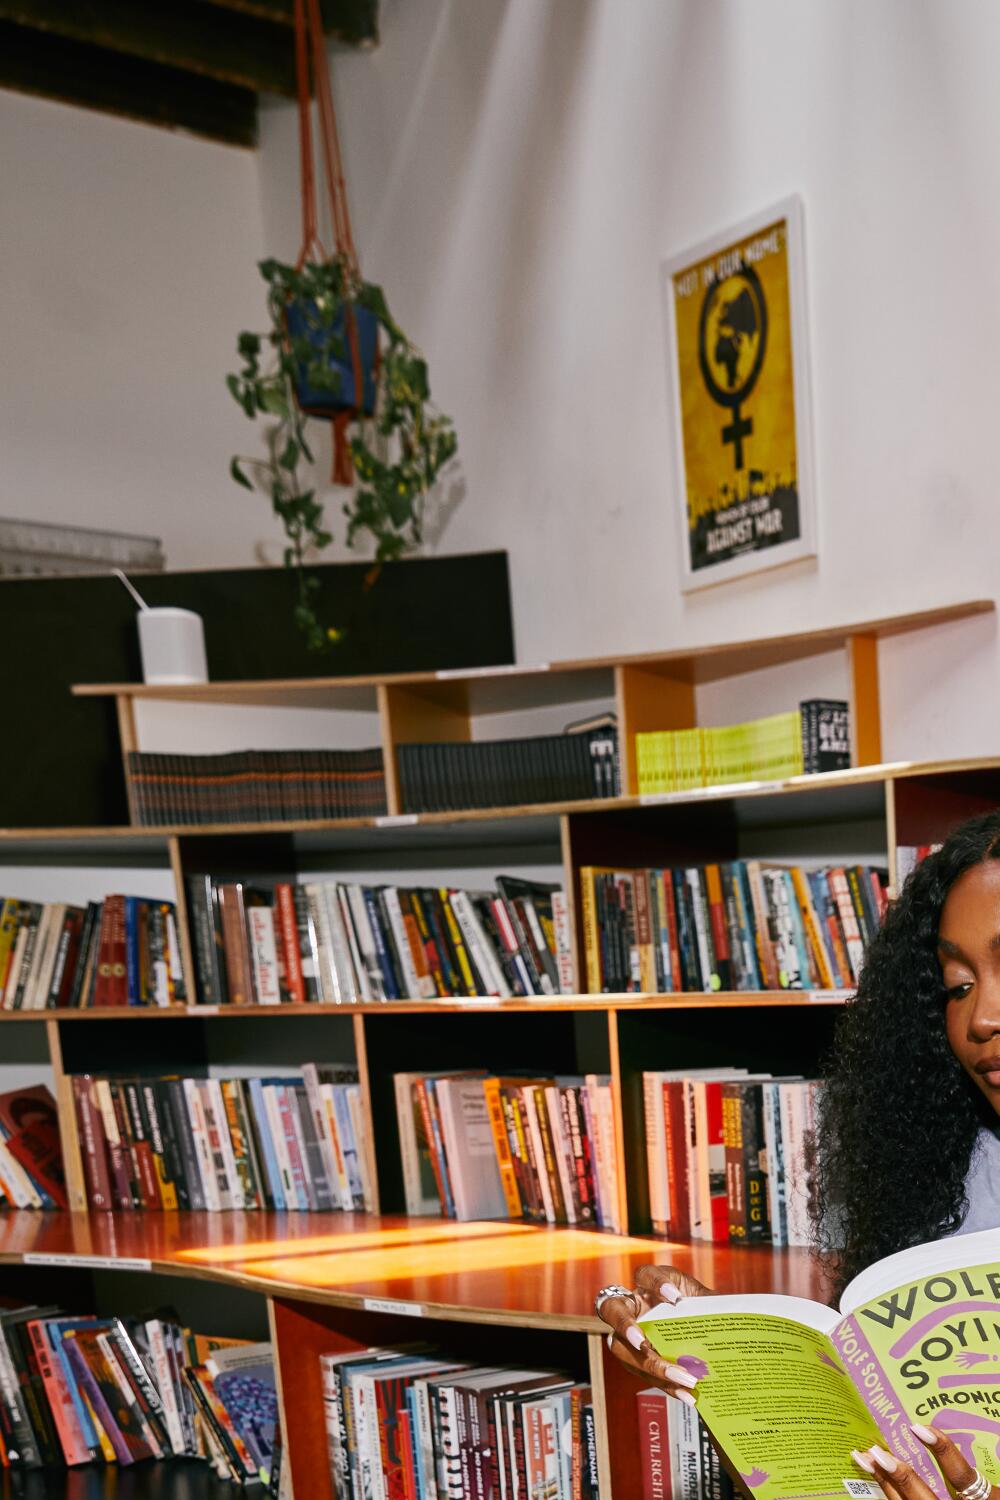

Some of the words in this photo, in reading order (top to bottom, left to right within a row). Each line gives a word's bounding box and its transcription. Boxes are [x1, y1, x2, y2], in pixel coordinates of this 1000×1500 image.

[836, 1319, 868, 1366] WOLE
[861, 1362, 900, 1427] SOYINKA
[586, 1415, 598, 1485] #SAYHERNAME
[648, 1420, 661, 1456] CIVIL
[475, 1452, 482, 1465] NO
[476, 1468, 484, 1494] MORE
